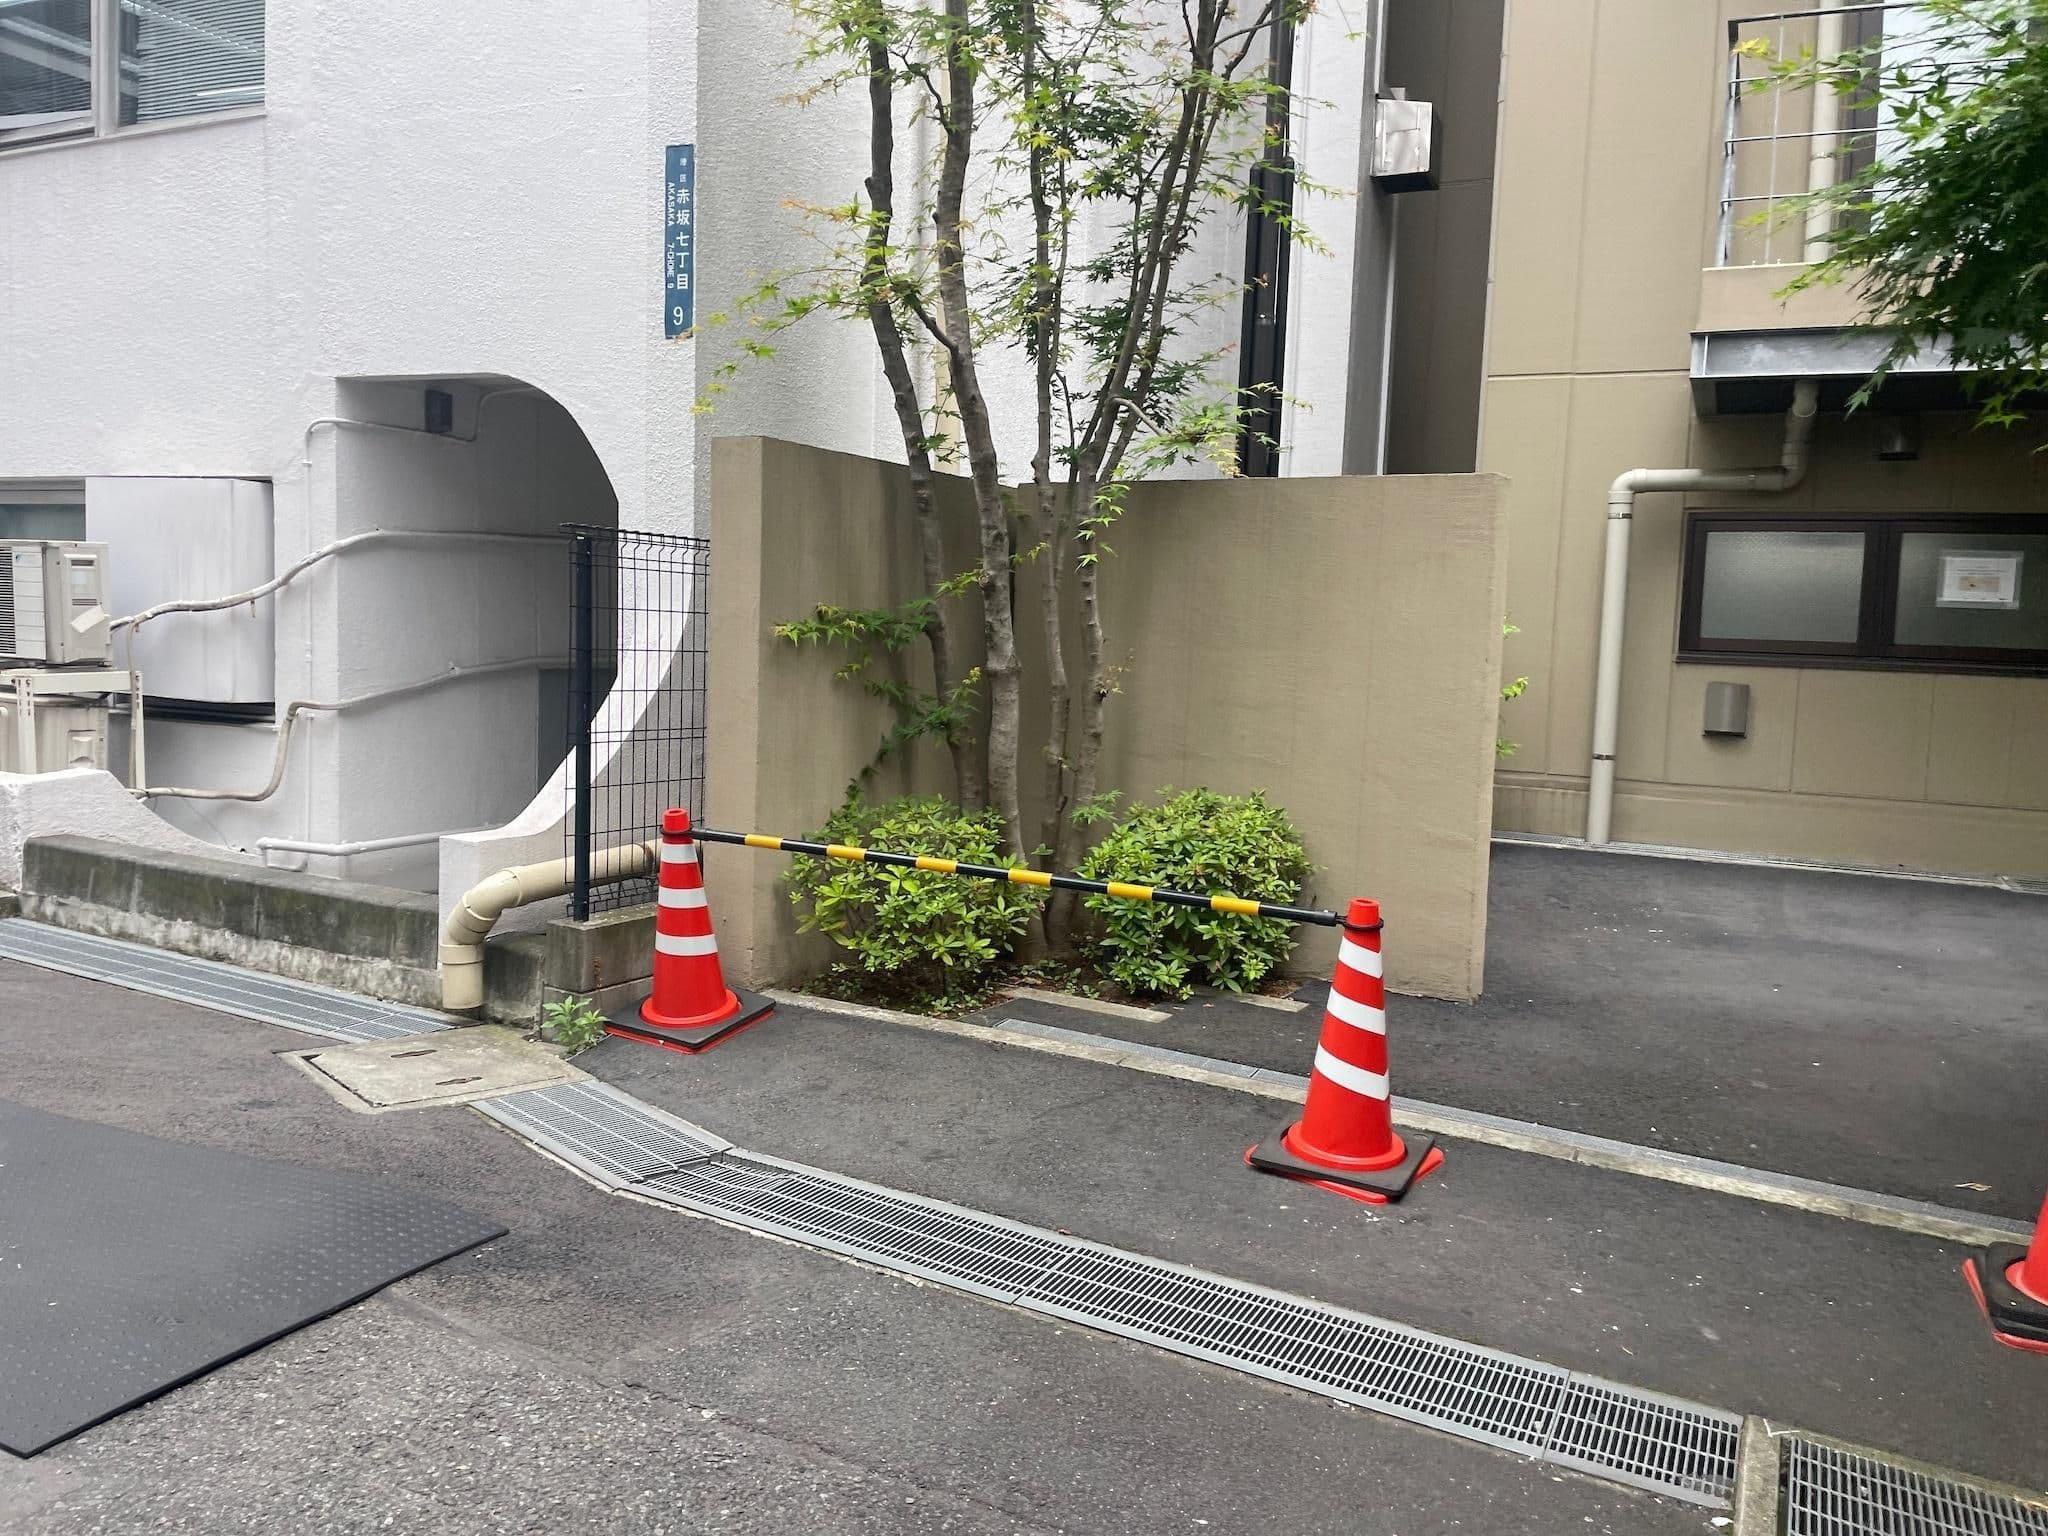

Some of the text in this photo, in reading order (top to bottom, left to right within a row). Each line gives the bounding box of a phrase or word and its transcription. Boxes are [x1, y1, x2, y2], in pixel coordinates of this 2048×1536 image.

[667, 181, 676, 227] AKASAKA
[667, 242, 675, 278] 7-CHOME
[673, 188, 691, 326] 赤坂七丁目 9
